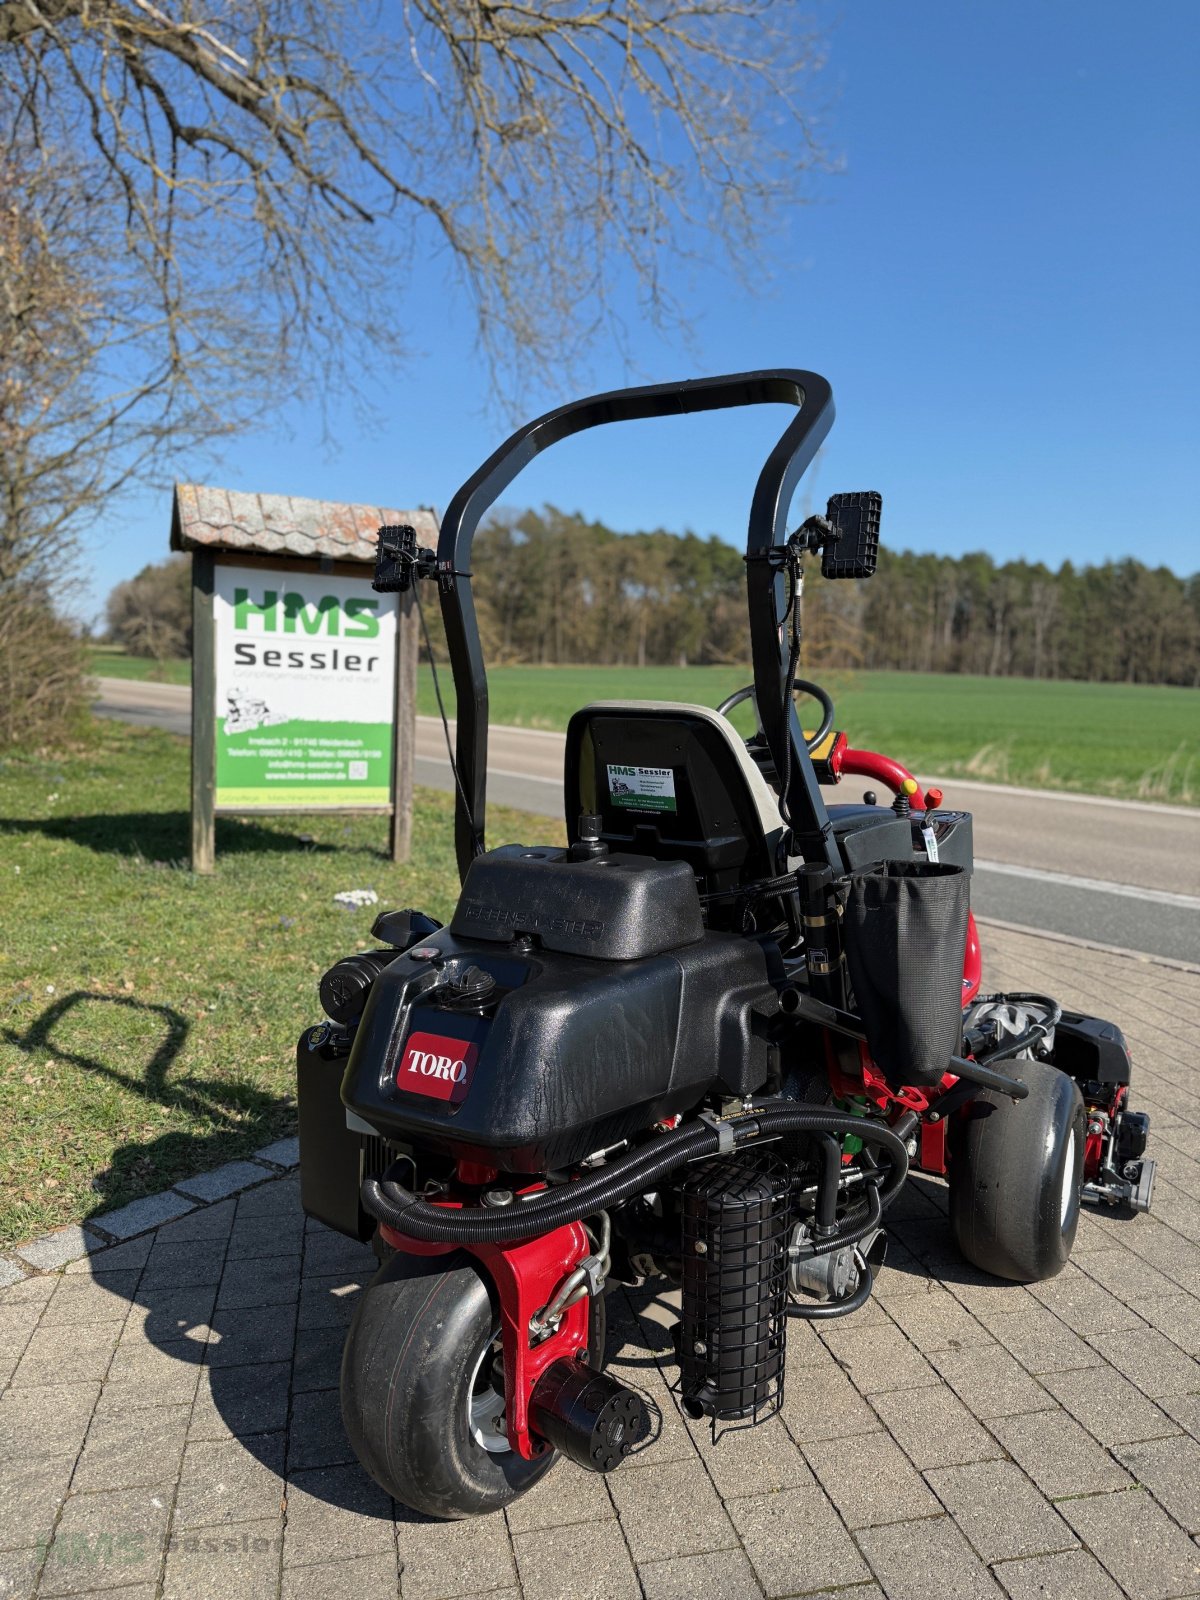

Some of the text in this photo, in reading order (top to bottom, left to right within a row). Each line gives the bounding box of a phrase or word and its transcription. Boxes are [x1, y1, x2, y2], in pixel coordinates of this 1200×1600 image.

[234, 588, 380, 638] HMS
[234, 643, 380, 672] Sessler
[609, 766, 635, 776] HMS
[408, 1050, 467, 1083] TORO
